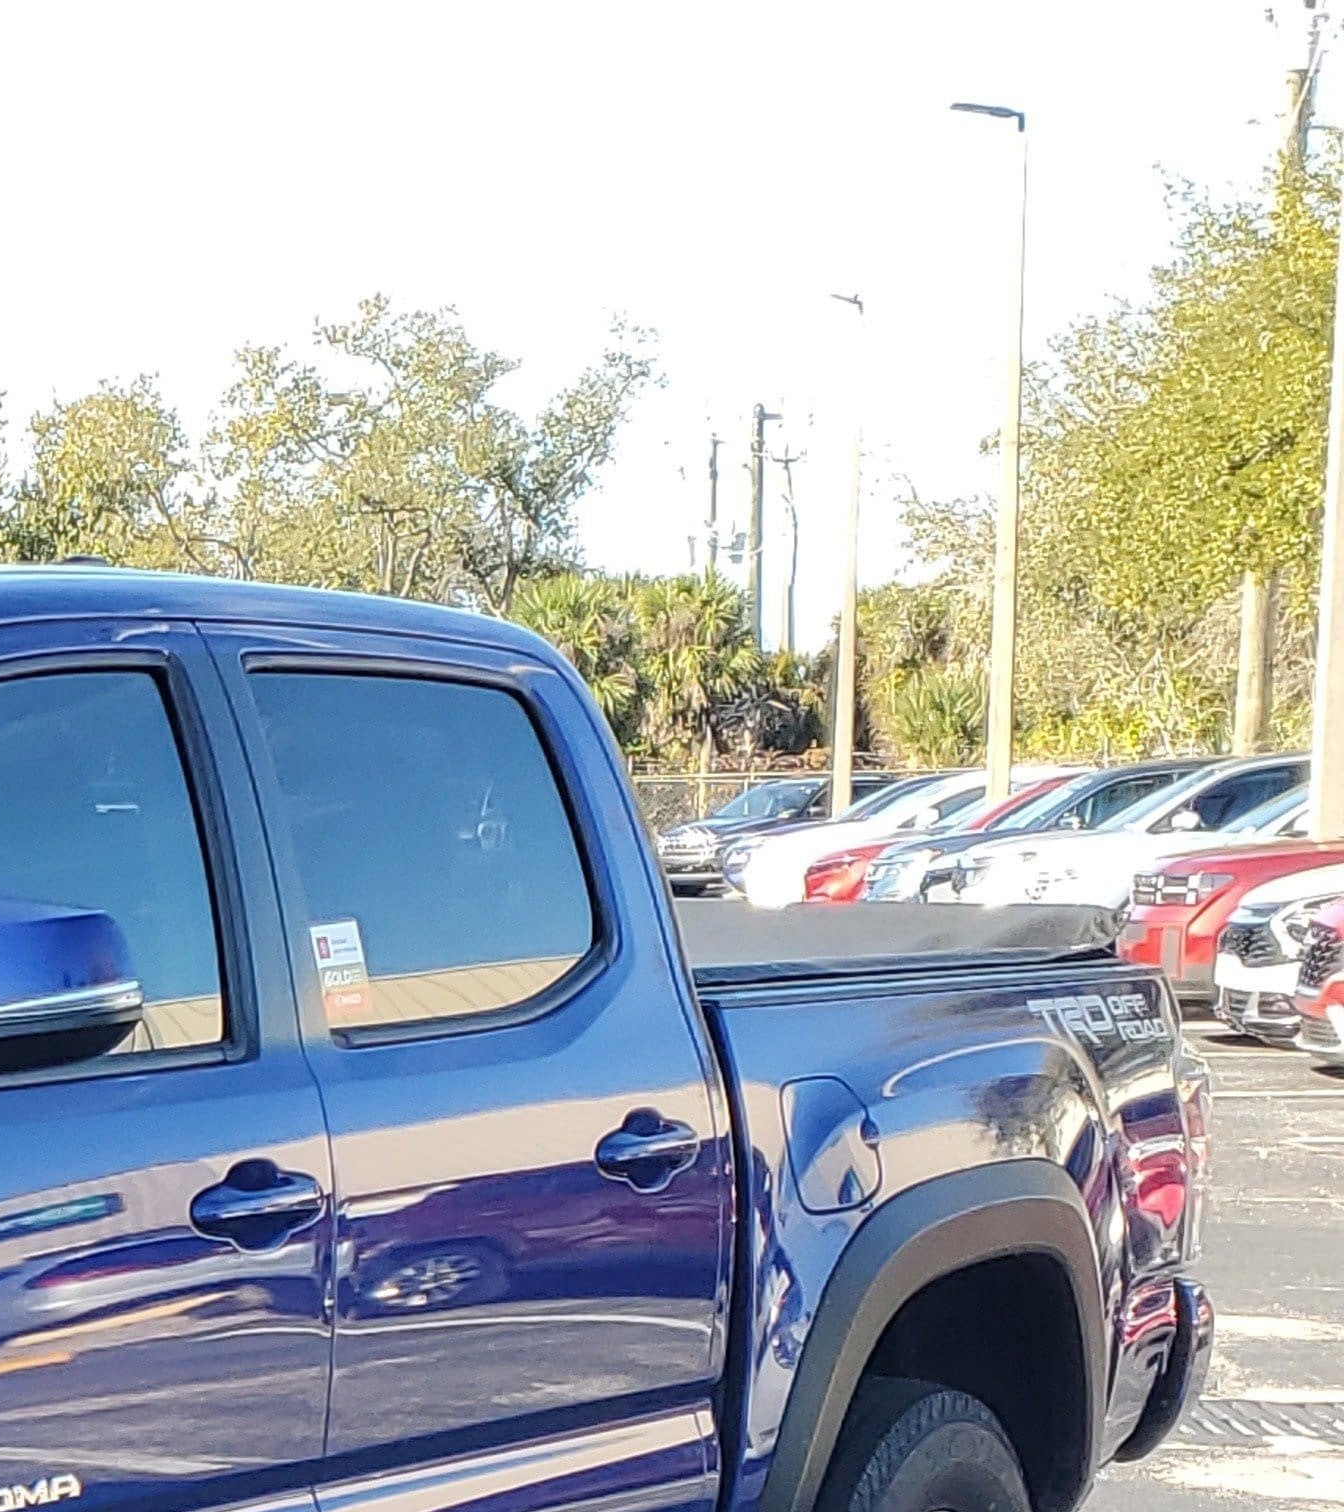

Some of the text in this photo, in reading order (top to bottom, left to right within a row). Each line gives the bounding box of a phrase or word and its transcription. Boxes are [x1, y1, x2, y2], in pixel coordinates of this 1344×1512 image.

[1026, 993, 1147, 1047] TRD OFF
[1118, 1018, 1169, 1041] ROAD
